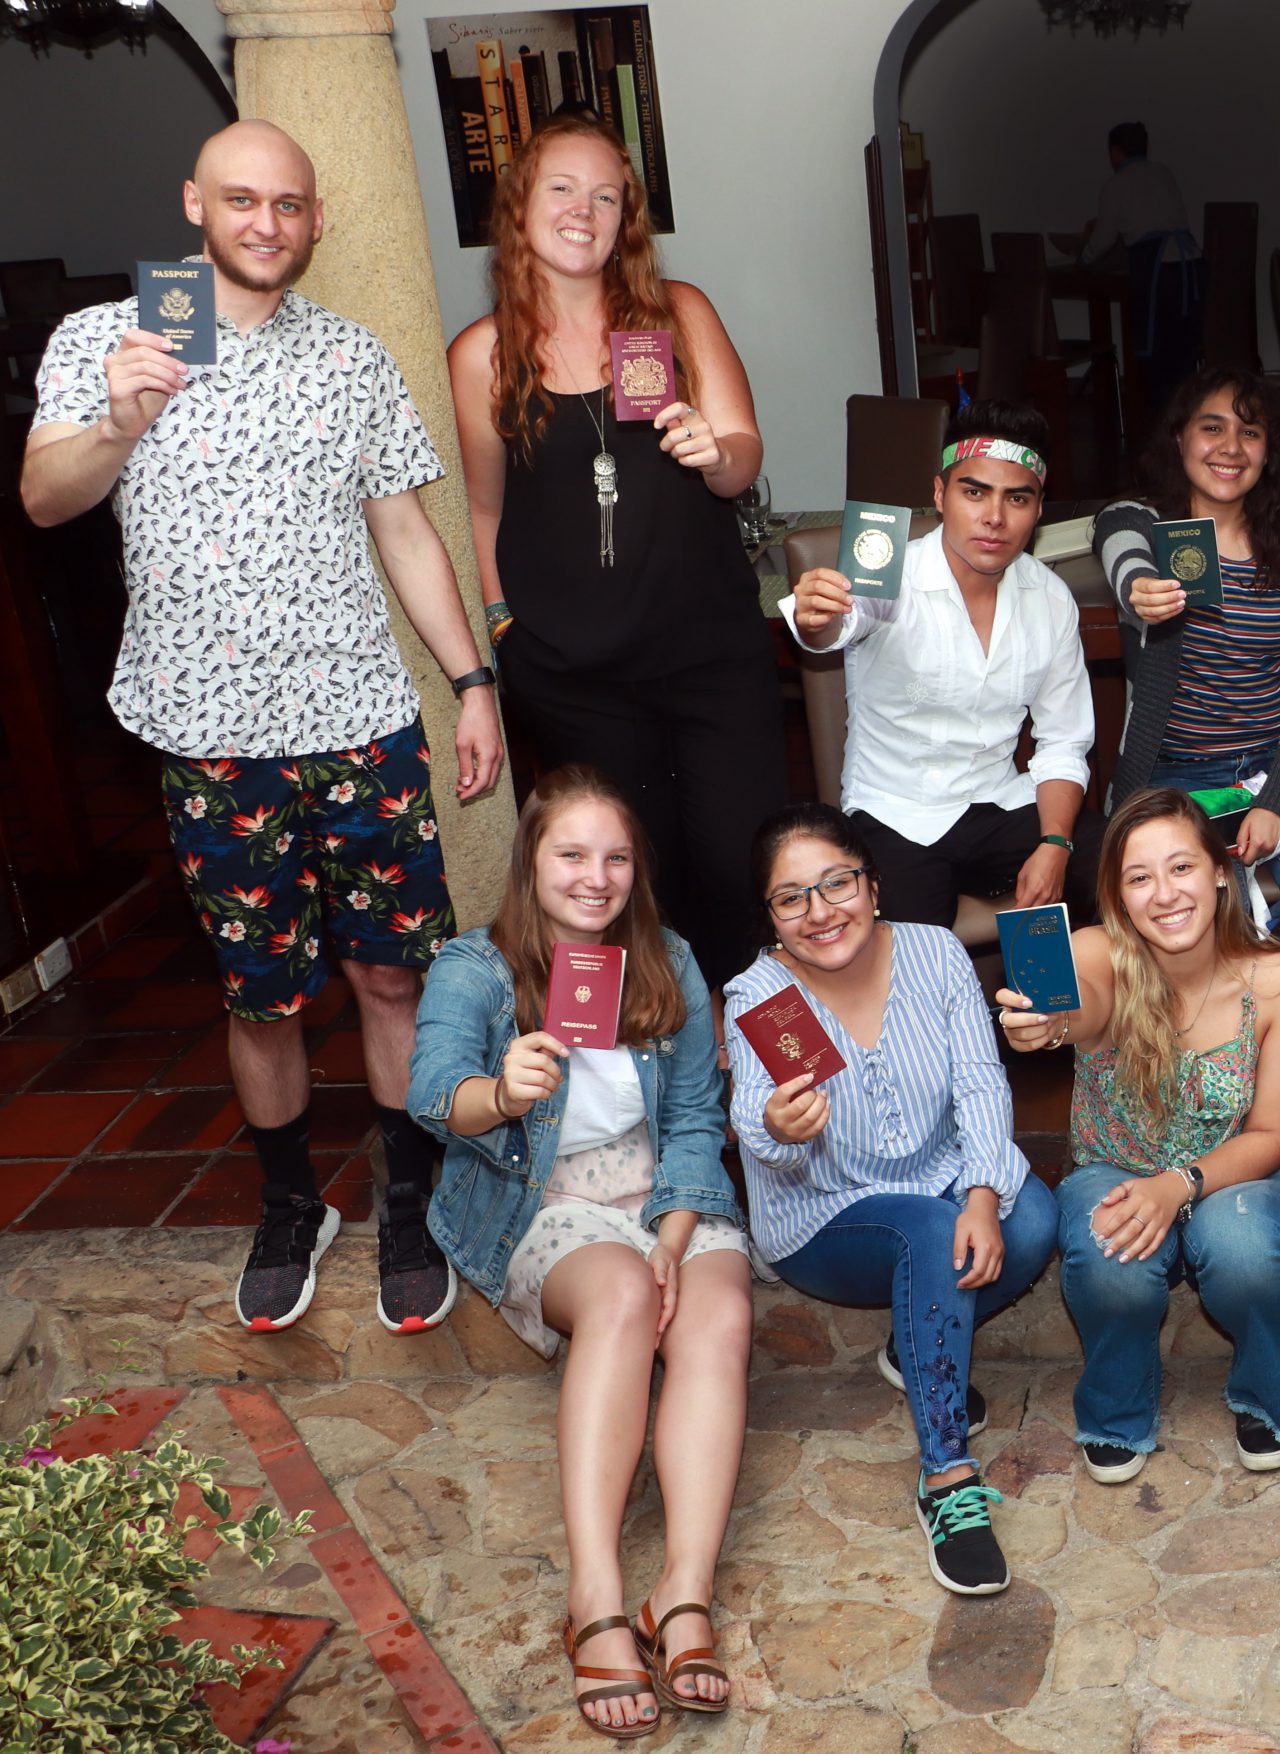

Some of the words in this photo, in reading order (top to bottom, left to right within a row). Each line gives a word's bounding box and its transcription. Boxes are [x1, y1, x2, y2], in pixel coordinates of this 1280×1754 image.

[632, 19, 645, 63] ROLLING
[636, 64, 648, 95] STONE
[642, 103, 651, 121] THE
[461, 111, 493, 174] ARTE
[643, 121, 658, 193] PHOTOGRAPHS
[152, 270, 199, 278] PASSPORT
[954, 437, 1045, 476] MEXICO
[859, 511, 896, 524] MEXICO
[1168, 529, 1201, 538] MEXICO
[561, 1021, 597, 1030] REISEPASS
